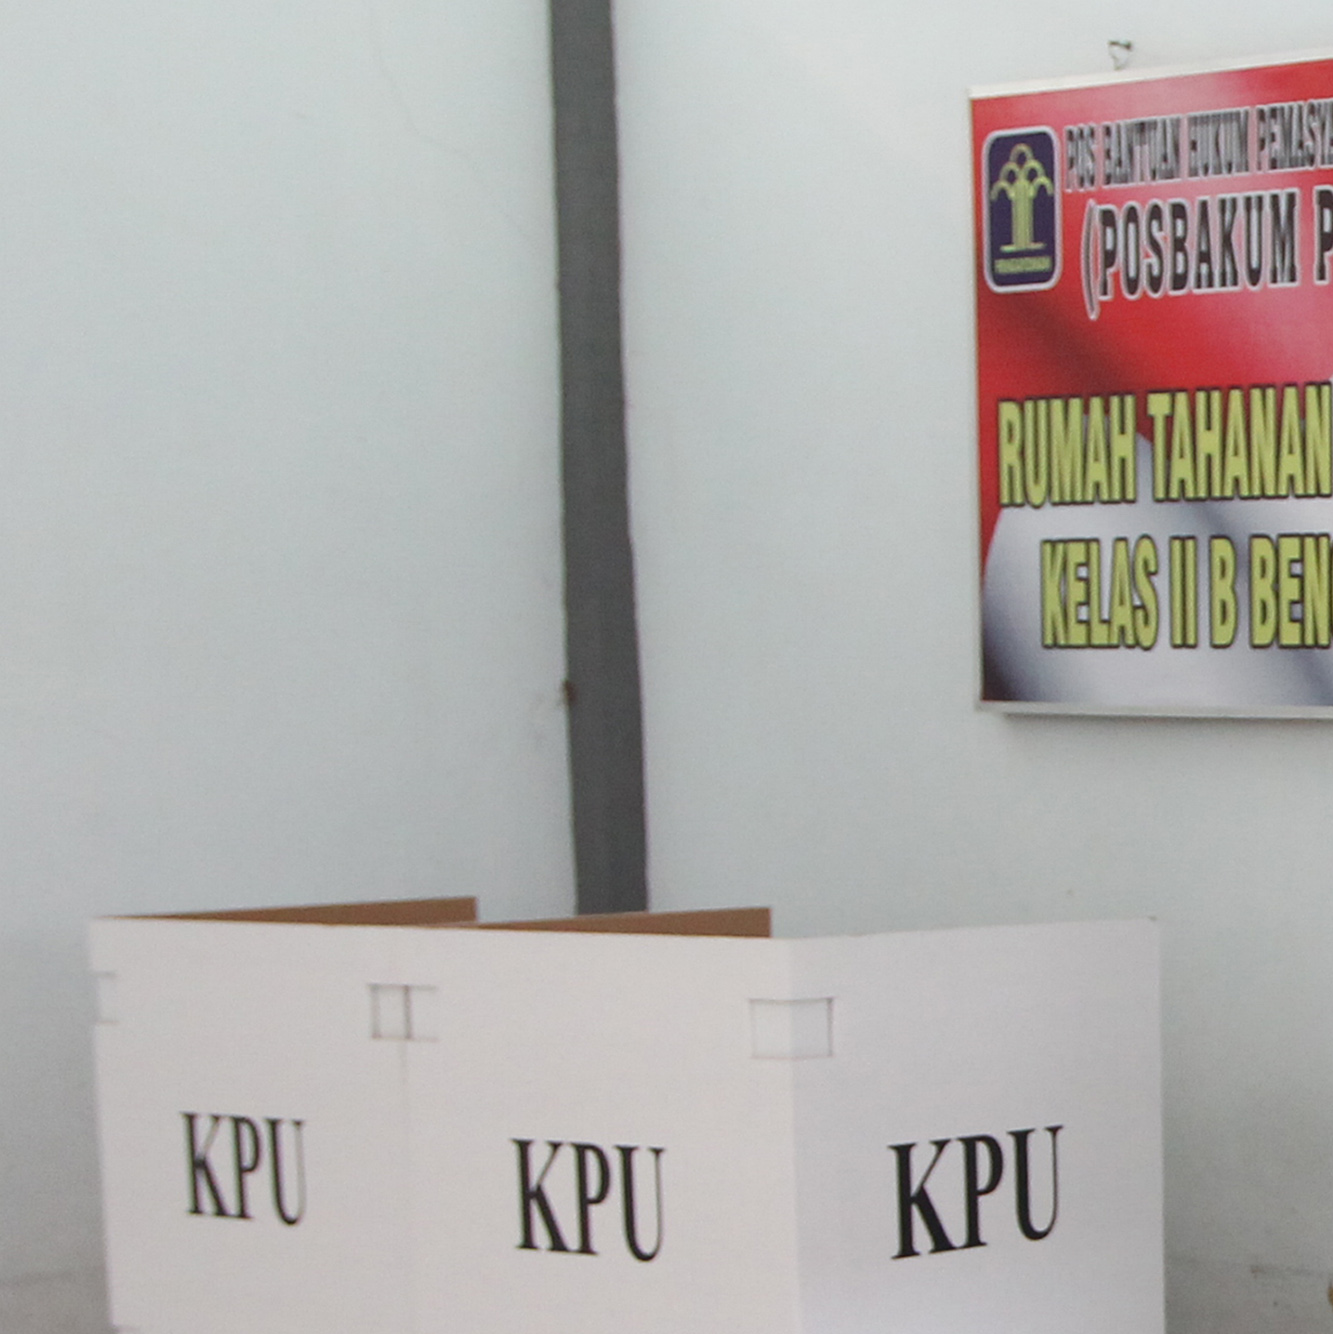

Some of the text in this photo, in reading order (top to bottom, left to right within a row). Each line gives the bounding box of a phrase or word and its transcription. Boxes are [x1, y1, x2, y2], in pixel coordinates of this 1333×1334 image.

[1081, 188, 1299, 320] (POSBAKUM
[998, 393, 1137, 509] RUMAH
[1146, 381, 1333, 502] TAHANAN
[1040, 534, 1160, 650] KELAS
[1208, 534, 1238, 650] B
[181, 1112, 307, 1226] KPU
[510, 1138, 666, 1262] KPU
[887, 1124, 1064, 1260] KPU
